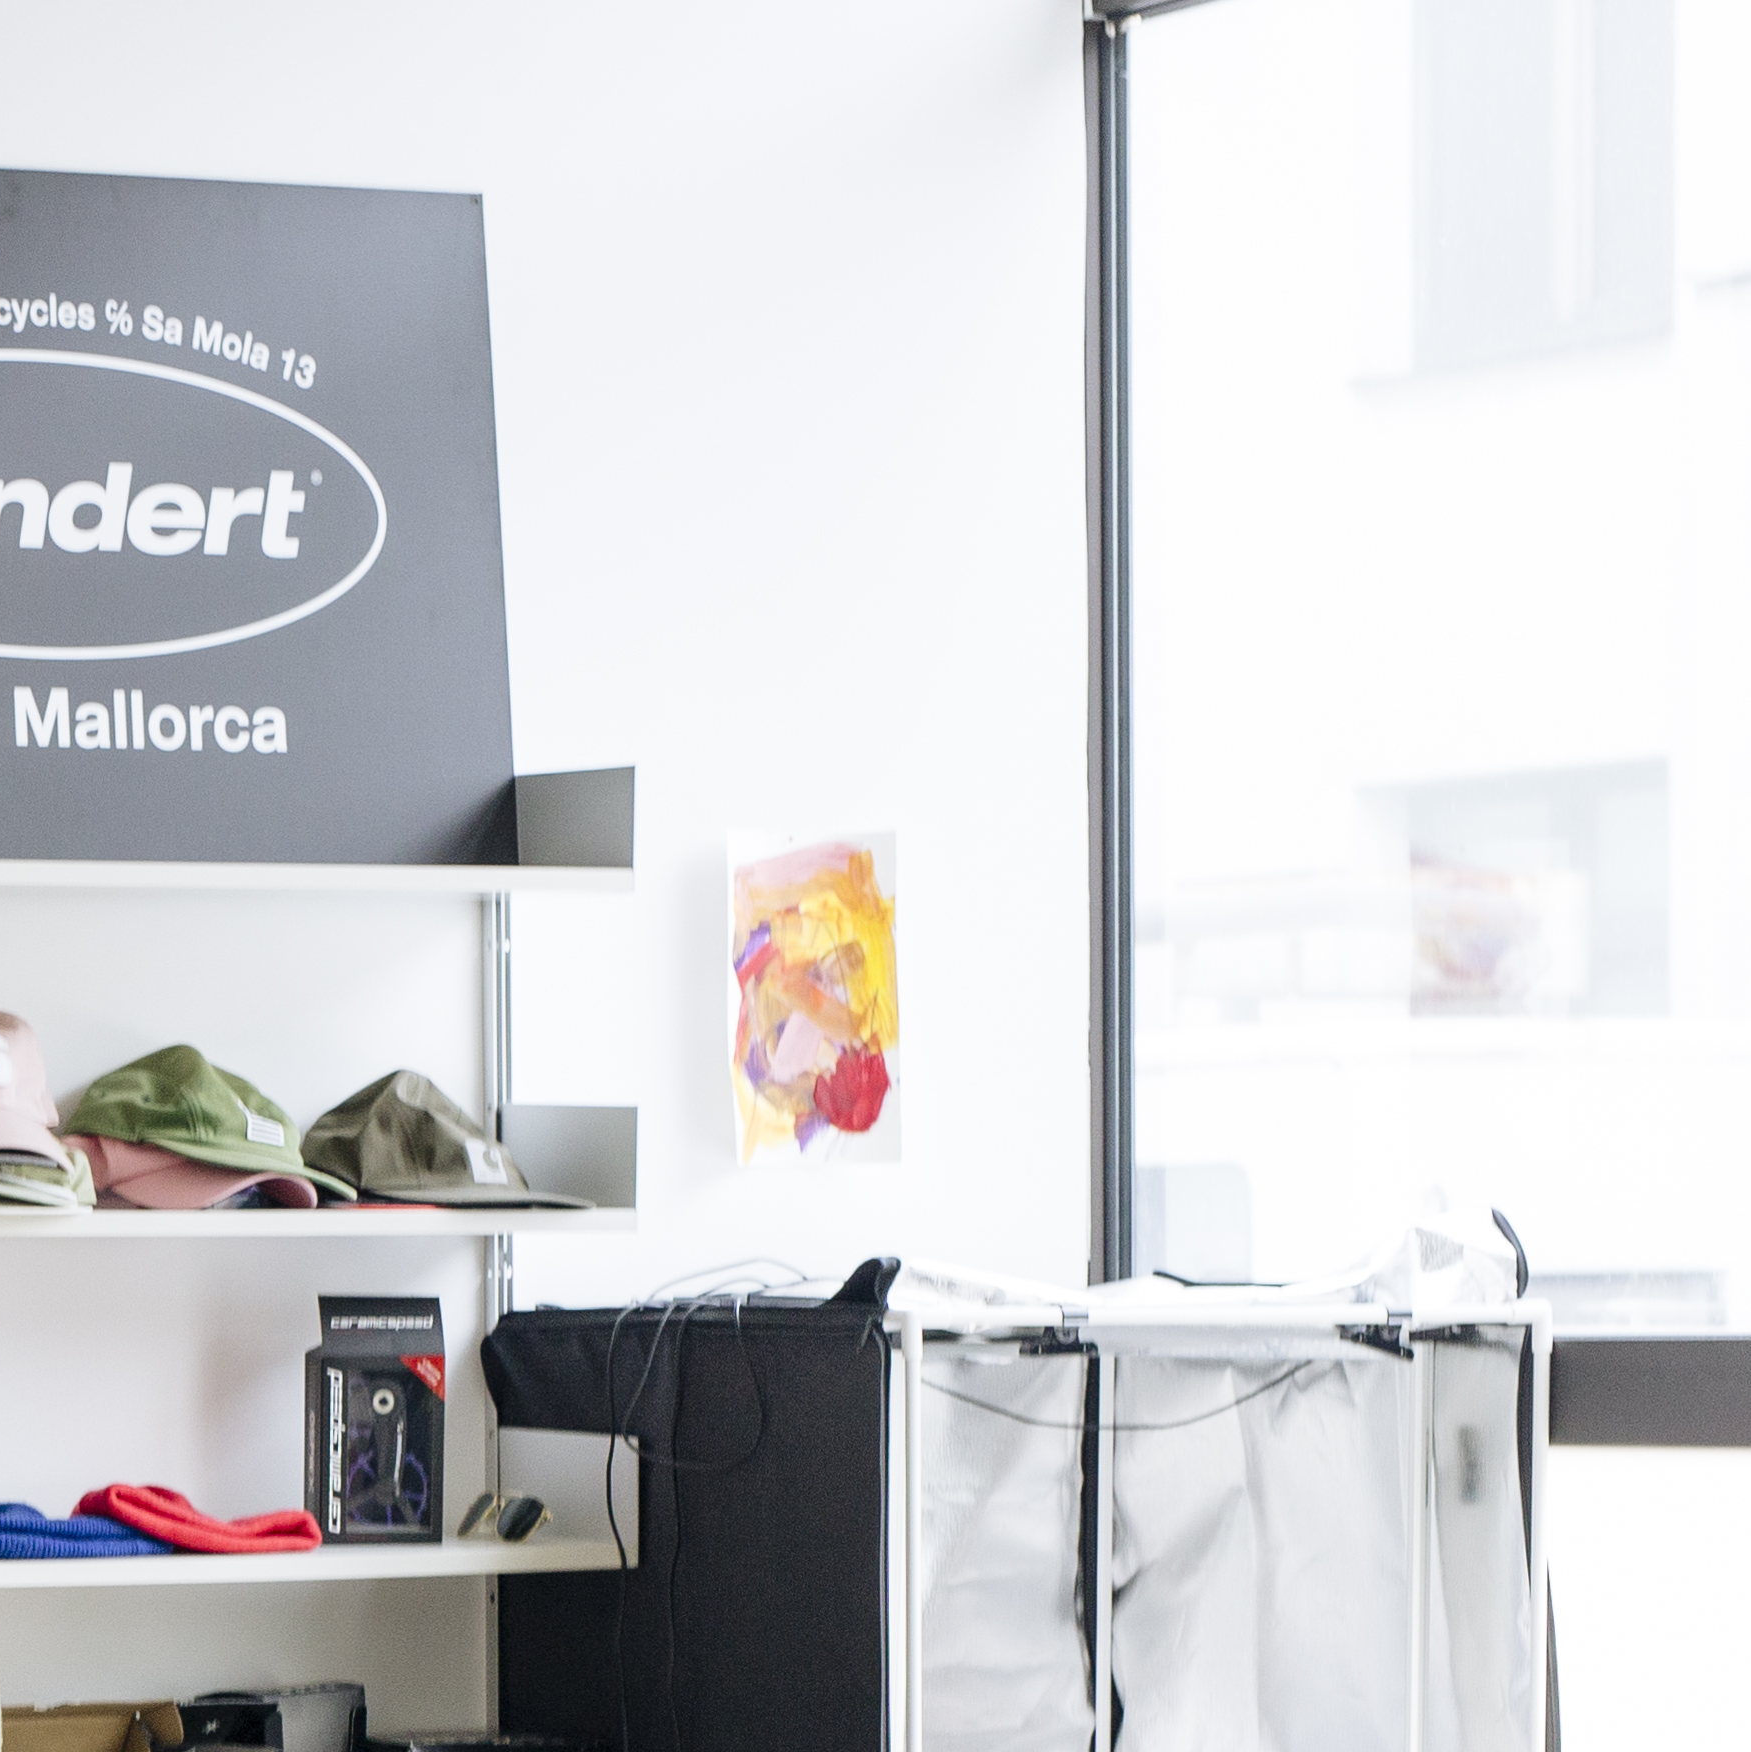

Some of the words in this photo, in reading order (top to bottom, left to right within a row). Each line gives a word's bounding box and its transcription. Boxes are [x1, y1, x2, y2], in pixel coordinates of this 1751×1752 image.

[142, 304, 183, 346] Sa
[192, 315, 270, 372] Mola
[281, 347, 316, 389] 13
[13, 686, 288, 754] Mallorca
